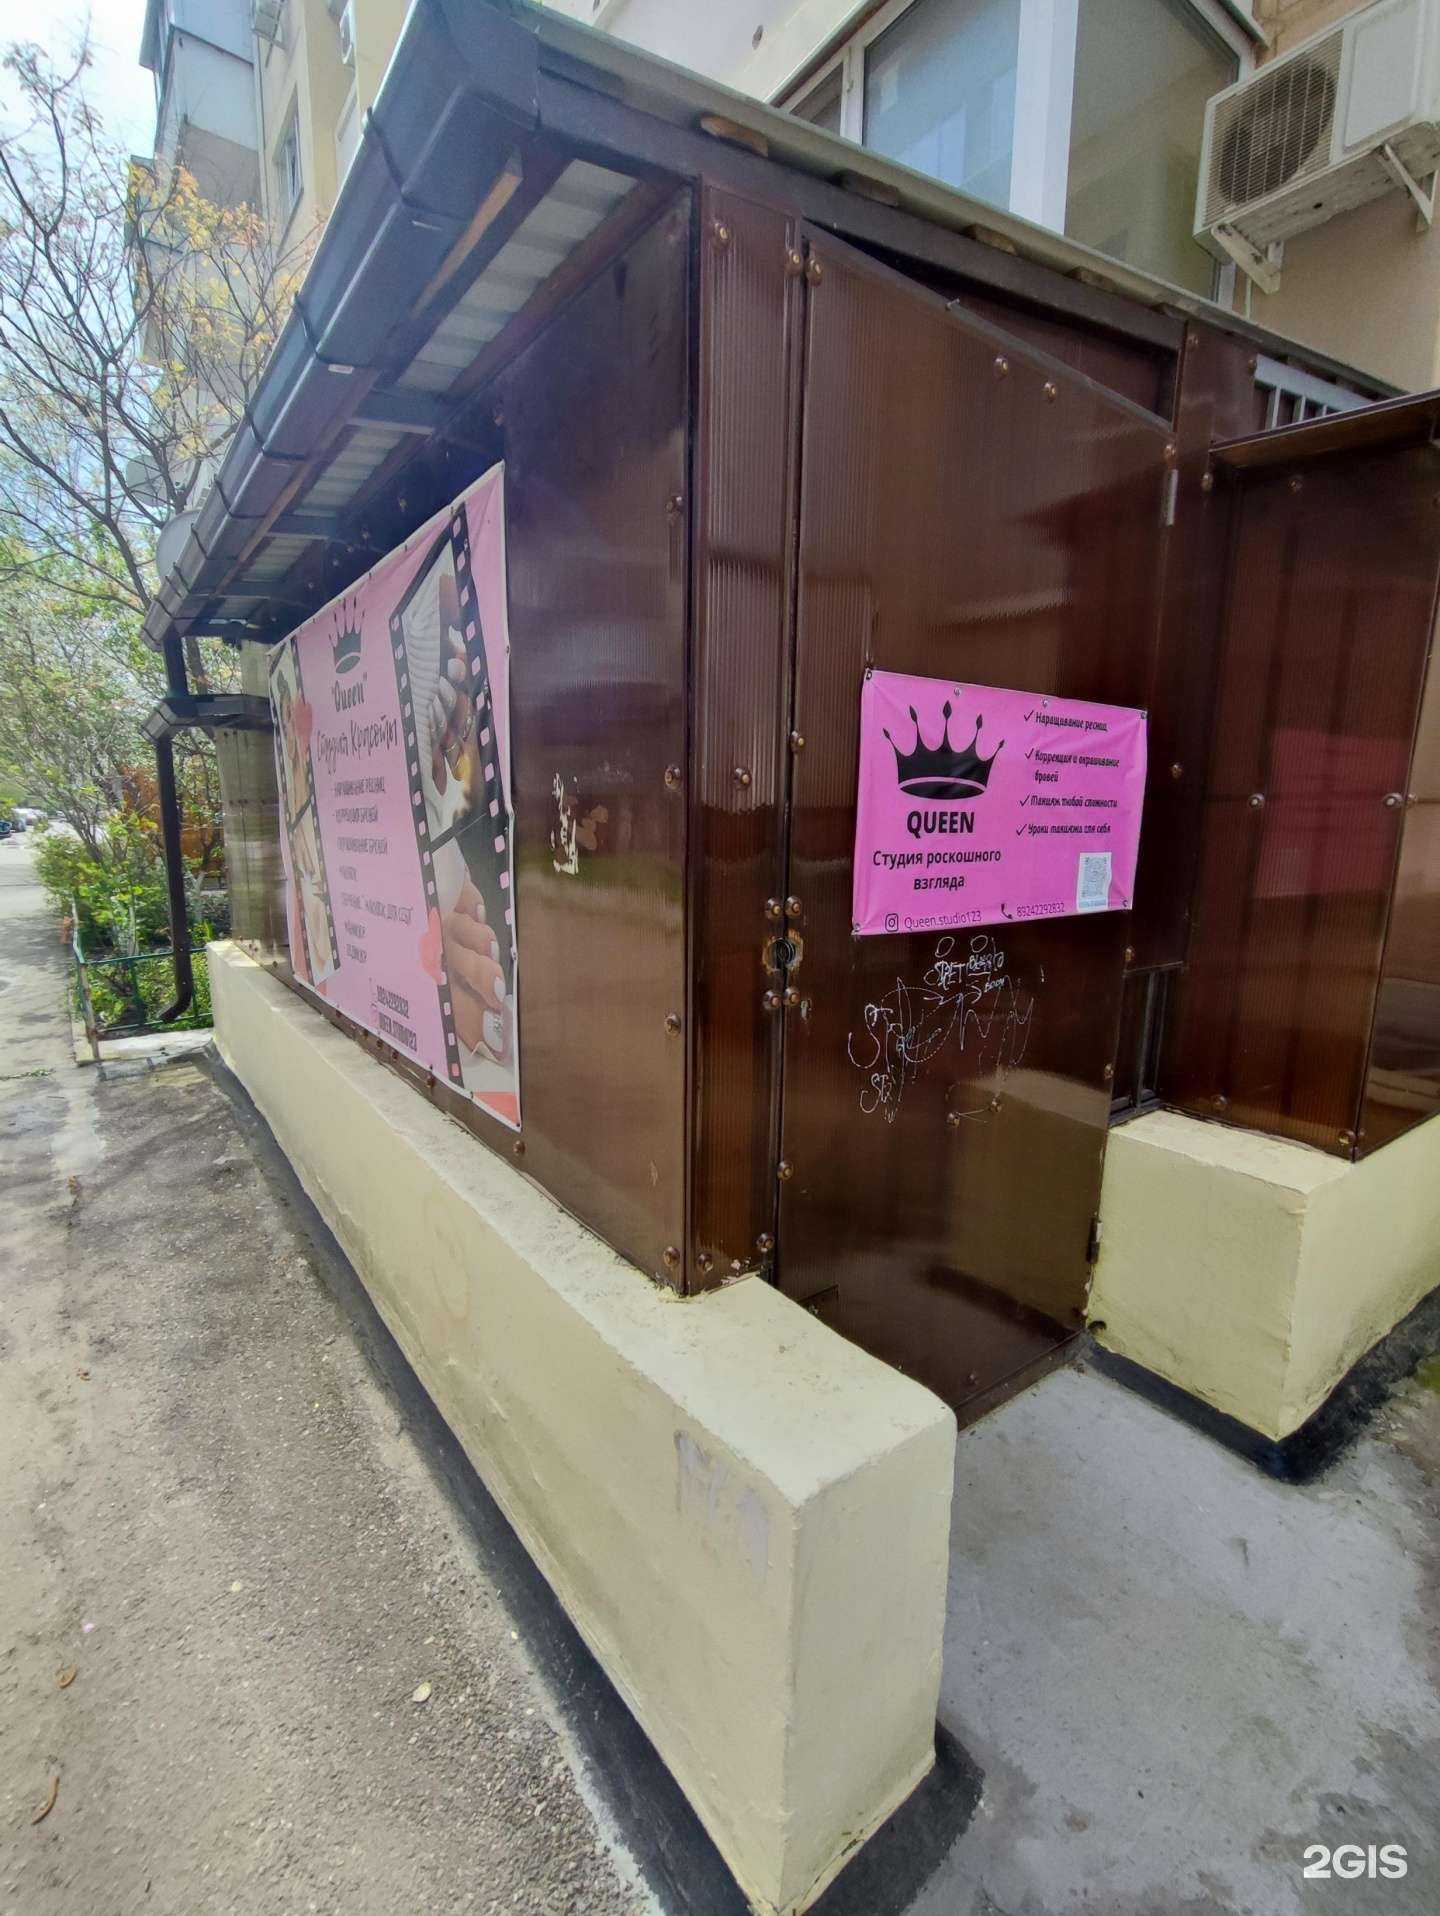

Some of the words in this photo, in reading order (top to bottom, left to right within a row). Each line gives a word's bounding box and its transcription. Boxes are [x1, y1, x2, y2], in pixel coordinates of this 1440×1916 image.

[1036, 711, 1083, 729] Наращивание
[1034, 769, 1059, 784] бровей
[907, 810, 975, 839] QUEEN
[872, 850, 923, 868] Студия
[926, 849, 1002, 871] роскошного
[913, 875, 965, 890] взгляда
